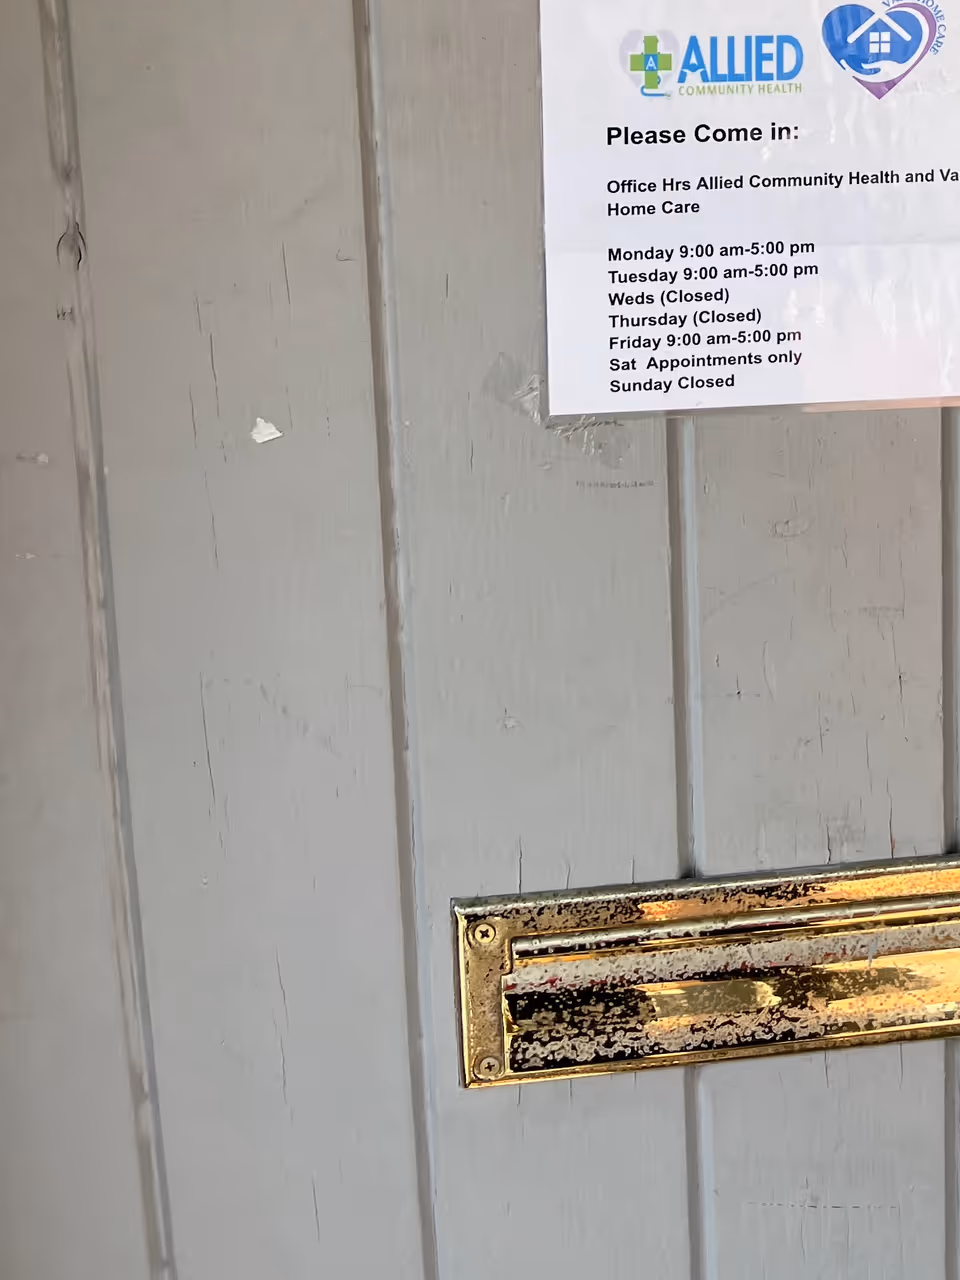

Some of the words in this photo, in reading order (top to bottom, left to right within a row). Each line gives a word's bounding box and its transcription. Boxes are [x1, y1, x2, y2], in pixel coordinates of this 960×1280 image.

[930, 24, 946, 55] CARE
[677, 35, 804, 83] ALLIED
[678, 85, 753, 96] COMMUNITY
[758, 83, 803, 94] HEALTH
[607, 126, 686, 146] Please
[694, 123, 763, 143] Come
[771, 121, 799, 141] in:
[606, 179, 657, 194] Office
[662, 177, 691, 192] Hrs
[696, 175, 744, 191] Allied
[749, 172, 844, 189] Community
[848, 170, 900, 185] Health
[904, 168, 935, 183] and
[607, 202, 656, 217] Home
[661, 200, 700, 215] Care
[608, 246, 675, 263] Monday
[679, 243, 714, 259] 9:00
[719, 240, 785, 257] am-5:00
[789, 242, 815, 257] pm
[607, 268, 678, 285] Tuesday
[683, 266, 718, 281] 9:00
[723, 263, 788, 279] am-5:00
[793, 264, 819, 279] pm
[608, 291, 655, 306] Weds
[660, 287, 730, 307] (Closed)
[608, 312, 688, 329] Thursday
[693, 307, 762, 328] (Closed)
[609, 335, 662, 351] Friday
[666, 332, 701, 347] 9:00
[706, 329, 771, 345] am-5:00
[776, 331, 802, 345] pm
[609, 358, 637, 372] Sat
[646, 352, 763, 373] Appointments
[767, 349, 803, 366] only
[609, 378, 673, 394] Sunday
[677, 373, 735, 390] Closed
